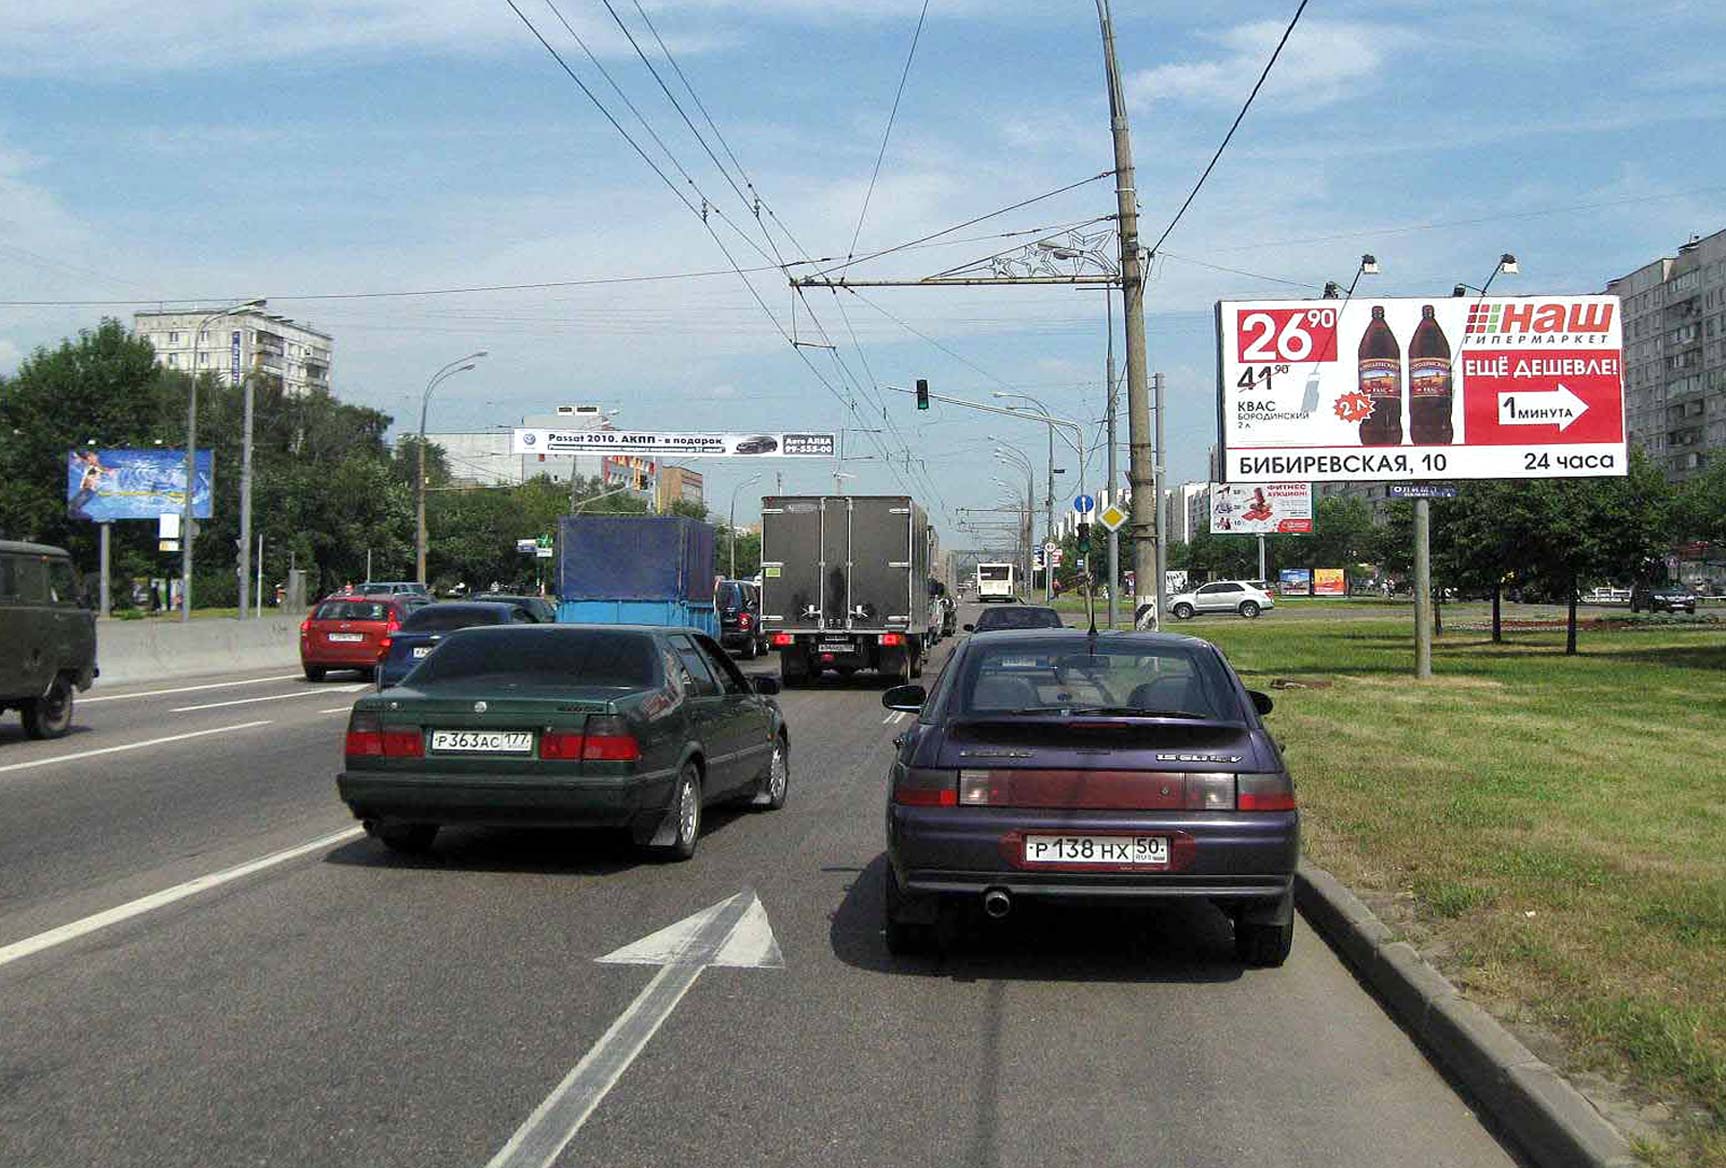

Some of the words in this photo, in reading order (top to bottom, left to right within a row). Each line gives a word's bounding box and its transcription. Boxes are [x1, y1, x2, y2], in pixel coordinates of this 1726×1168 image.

[1242, 313, 1312, 361] 26
[1307, 309, 1335, 328] 90
[1464, 334, 1609, 345] ГИПЕРМАРКЕТ
[1465, 356, 1509, 378] ЕЩЁ
[1513, 358, 1618, 378] ДЕШЕВЛЕ!
[1237, 366, 1272, 391] 41
[1238, 400, 1276, 412] КВАС
[1340, 401, 1352, 416] 2
[1503, 396, 1515, 419] 1
[1518, 408, 1574, 419] МИНУТА
[1238, 411, 1310, 421] БОРОДИНСКИЙ
[548, 433, 584, 443] Passat
[587, 434, 618, 443] 2010.
[621, 435, 655, 444] АКПП
[673, 437, 722, 446] подарок
[1240, 454, 1414, 474] БИБИРЕВСКАЯ,
[1422, 453, 1447, 472] 10
[1524, 452, 1550, 470] 24
[1557, 454, 1614, 469] часа
[1136, 838, 1160, 854] 50
